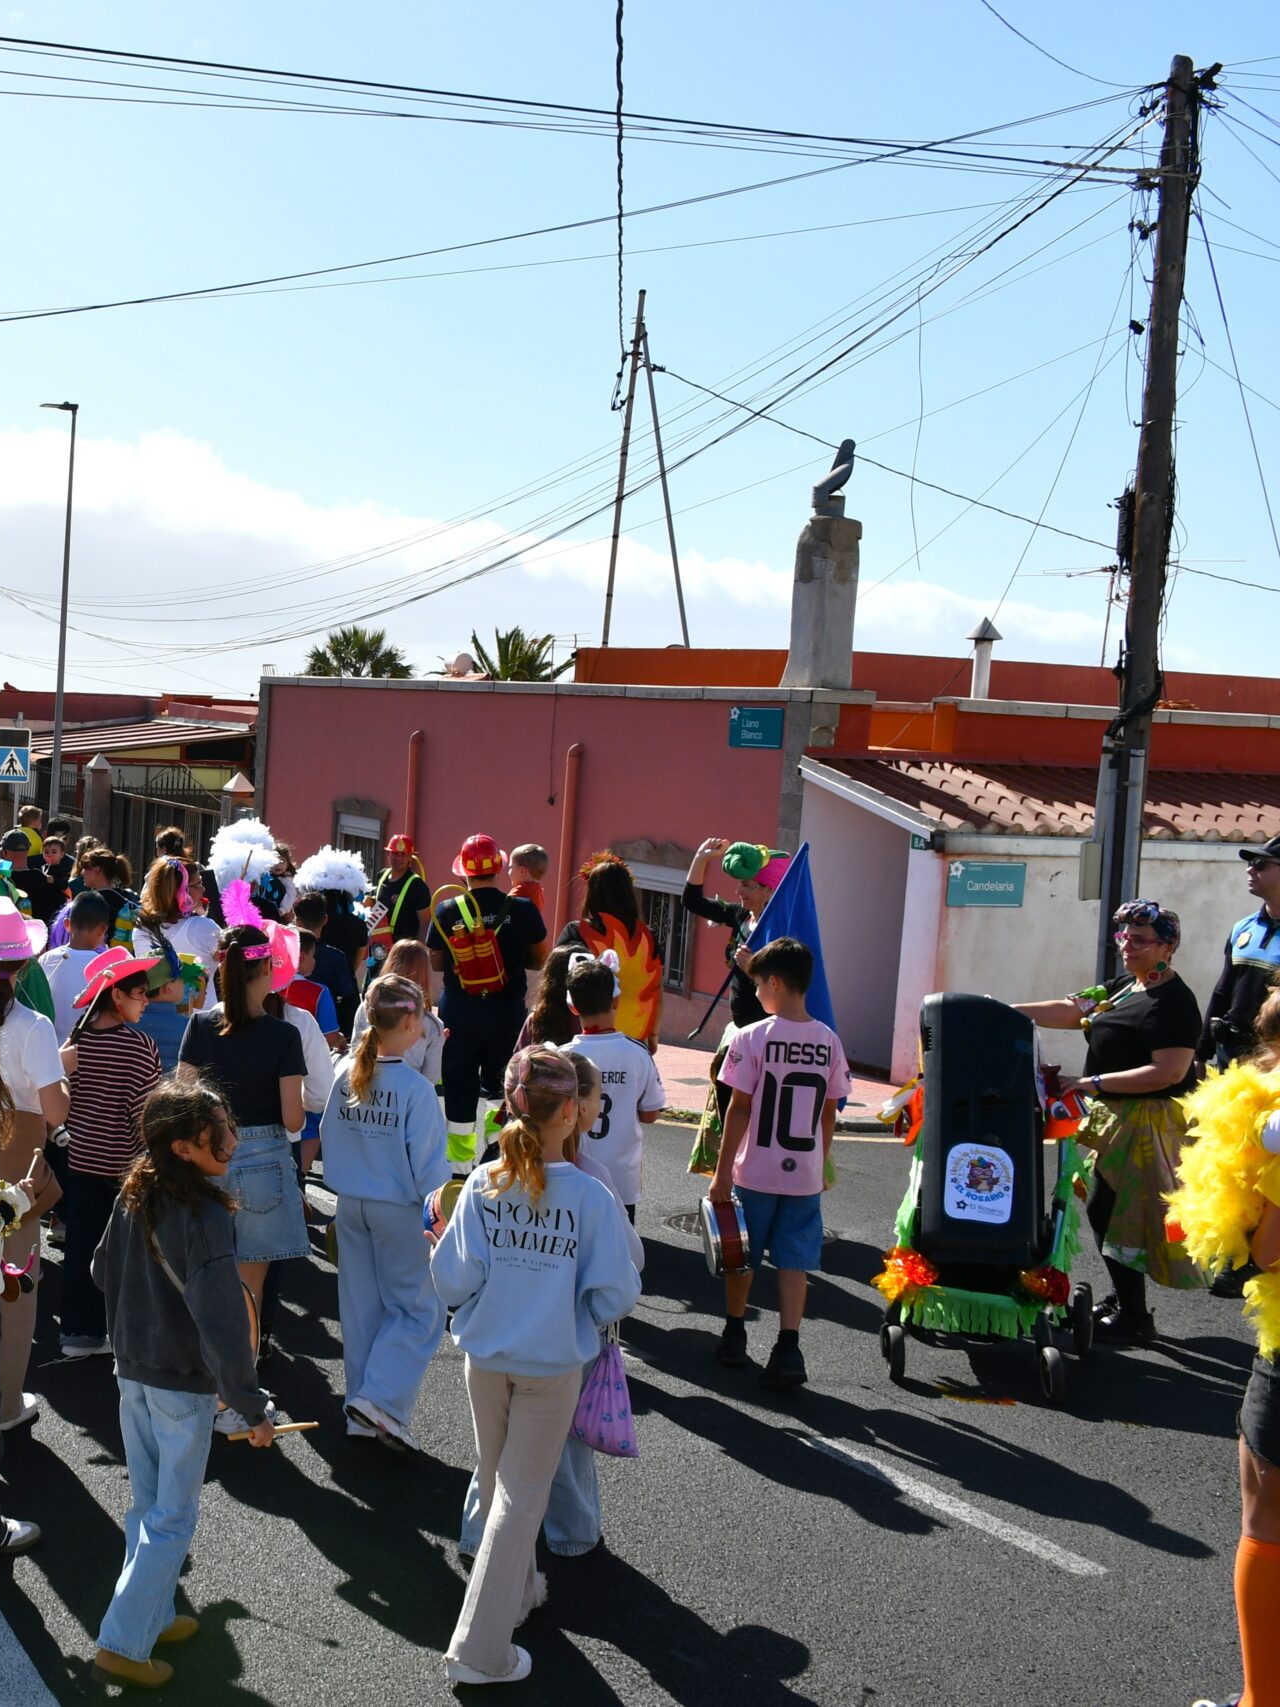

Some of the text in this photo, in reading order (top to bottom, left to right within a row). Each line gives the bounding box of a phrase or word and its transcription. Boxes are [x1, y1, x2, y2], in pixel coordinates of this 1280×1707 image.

[741, 730, 763, 740] Blanco
[913, 837, 926, 849] 8A
[966, 880, 1015, 892] Candelaria
[766, 1041, 831, 1067] MESSI
[600, 1071, 627, 1084] ERDE
[756, 1070, 827, 1152] 10
[482, 1200, 575, 1233] SPORTY
